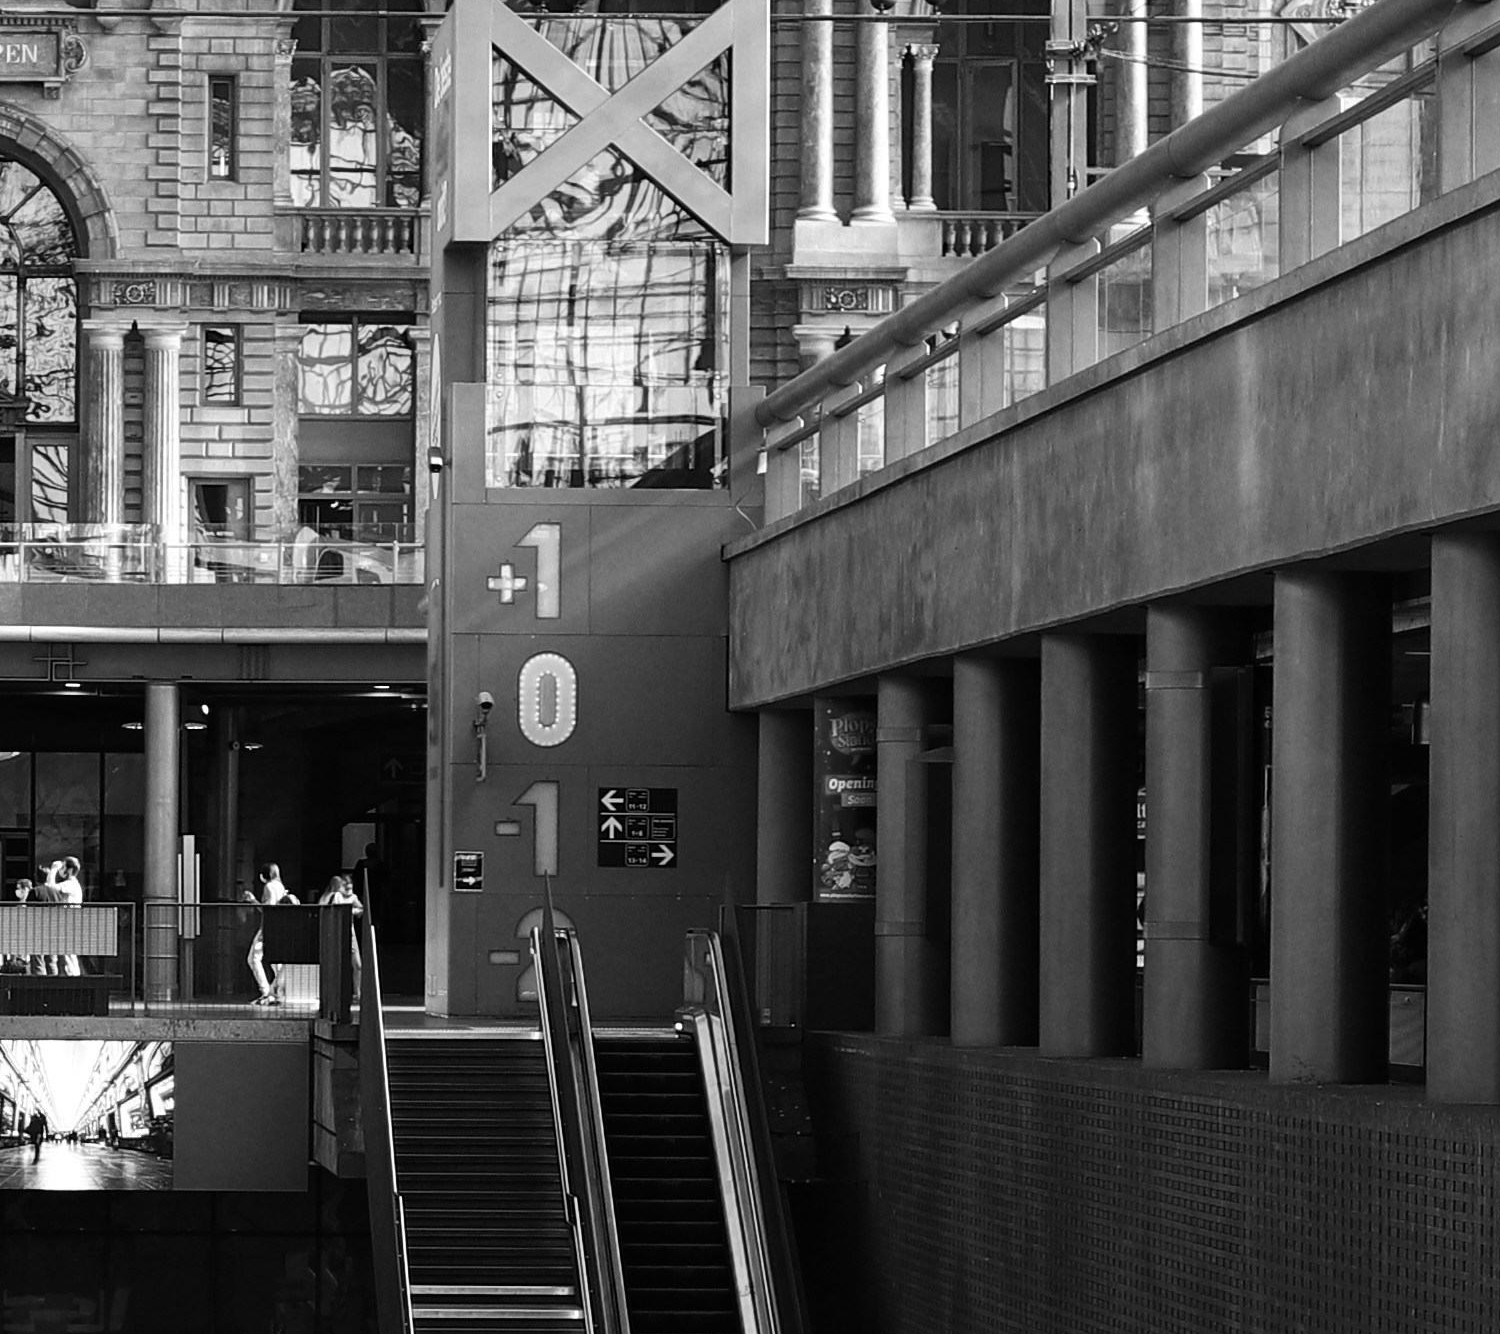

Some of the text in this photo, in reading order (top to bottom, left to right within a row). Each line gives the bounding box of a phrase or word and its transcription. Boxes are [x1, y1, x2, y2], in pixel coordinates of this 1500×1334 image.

[516, 651, 578, 748] 0
[829, 717, 876, 737] Plop
[828, 776, 876, 792] Openin
[846, 794, 873, 805] Soon
